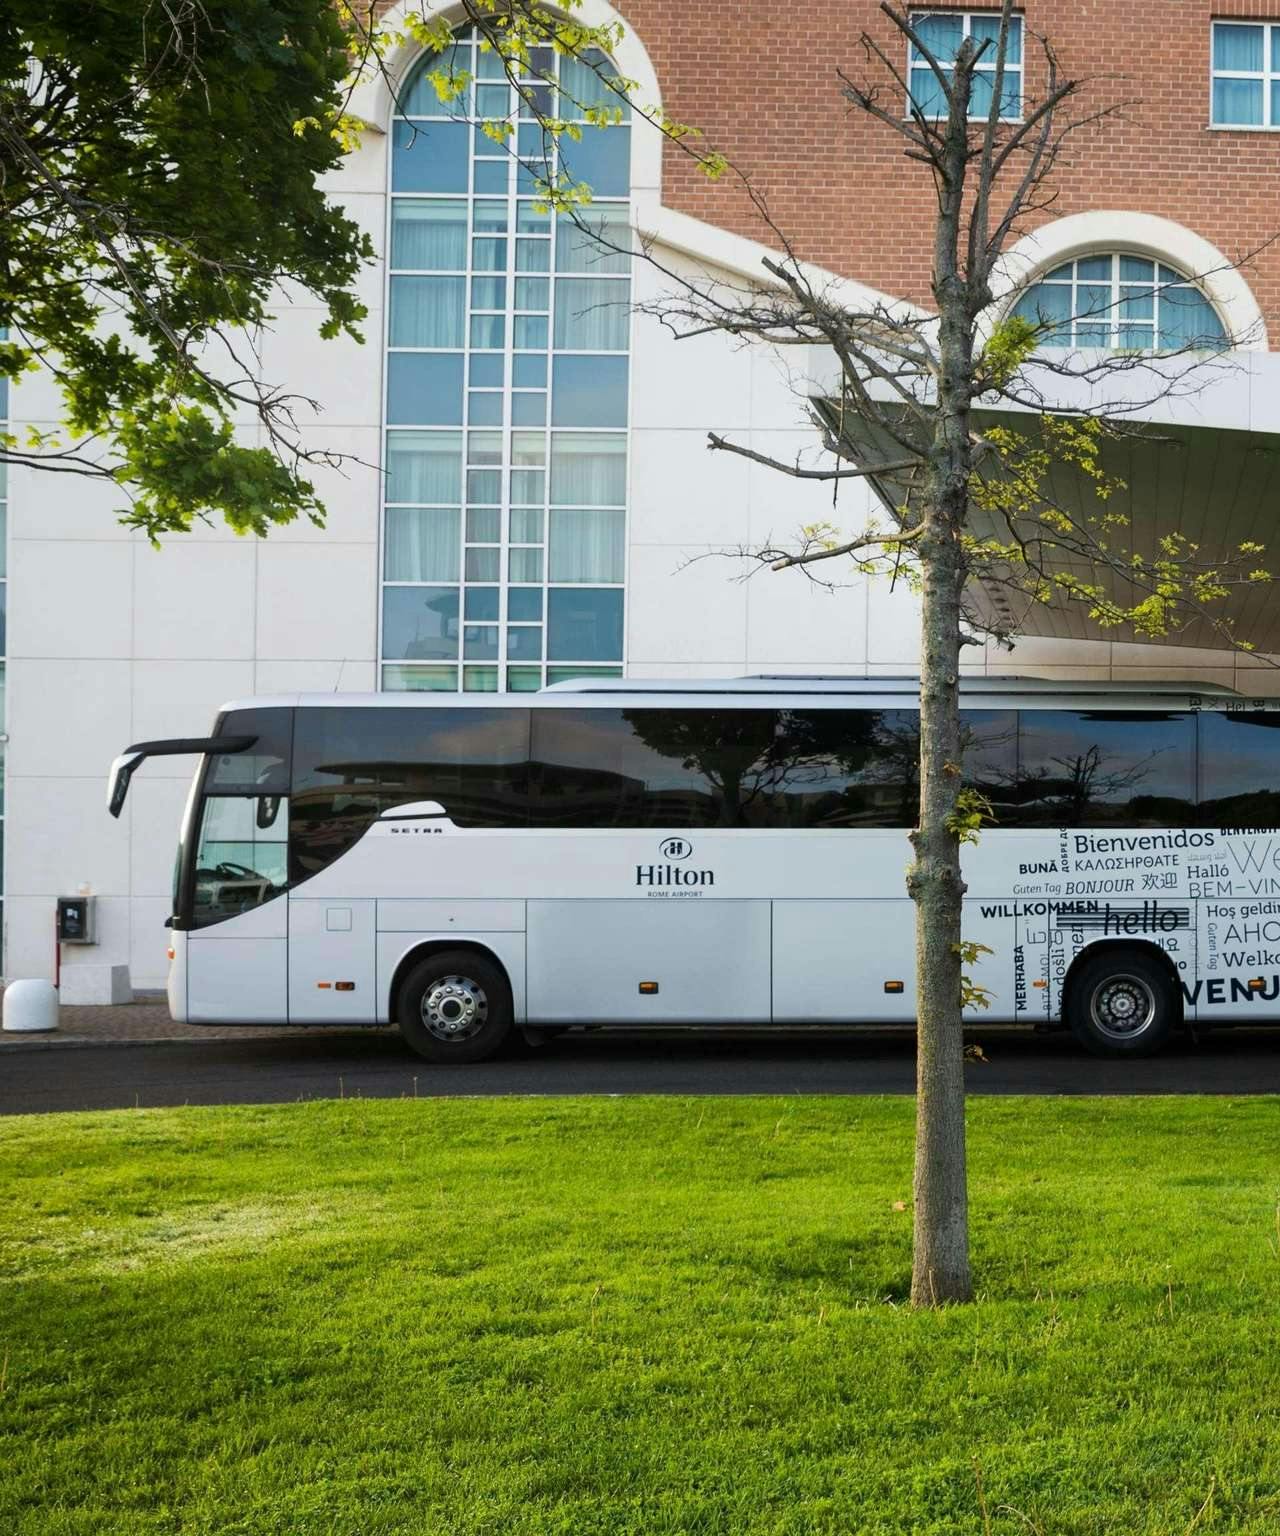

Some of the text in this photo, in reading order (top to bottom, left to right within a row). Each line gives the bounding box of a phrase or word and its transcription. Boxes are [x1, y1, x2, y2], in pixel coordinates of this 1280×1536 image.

[1074, 829, 1215, 854] Bienvenidos
[635, 864, 714, 886] Hilton
[1019, 860, 1059, 875] BUNĂ
[1187, 864, 1230, 879] Halló
[1013, 883, 1061, 896] Guten Tag
[1065, 879, 1135, 895] BONJOUR
[1141, 872, 1178, 890] 欢迎
[980, 900, 1099, 919] WILLKOMMEN
[1104, 900, 1179, 936] hello
[1206, 904, 1236, 919] Hoş
[1207, 922, 1219, 970] Guten Tag
[1013, 945, 1027, 1011] MERHABA
